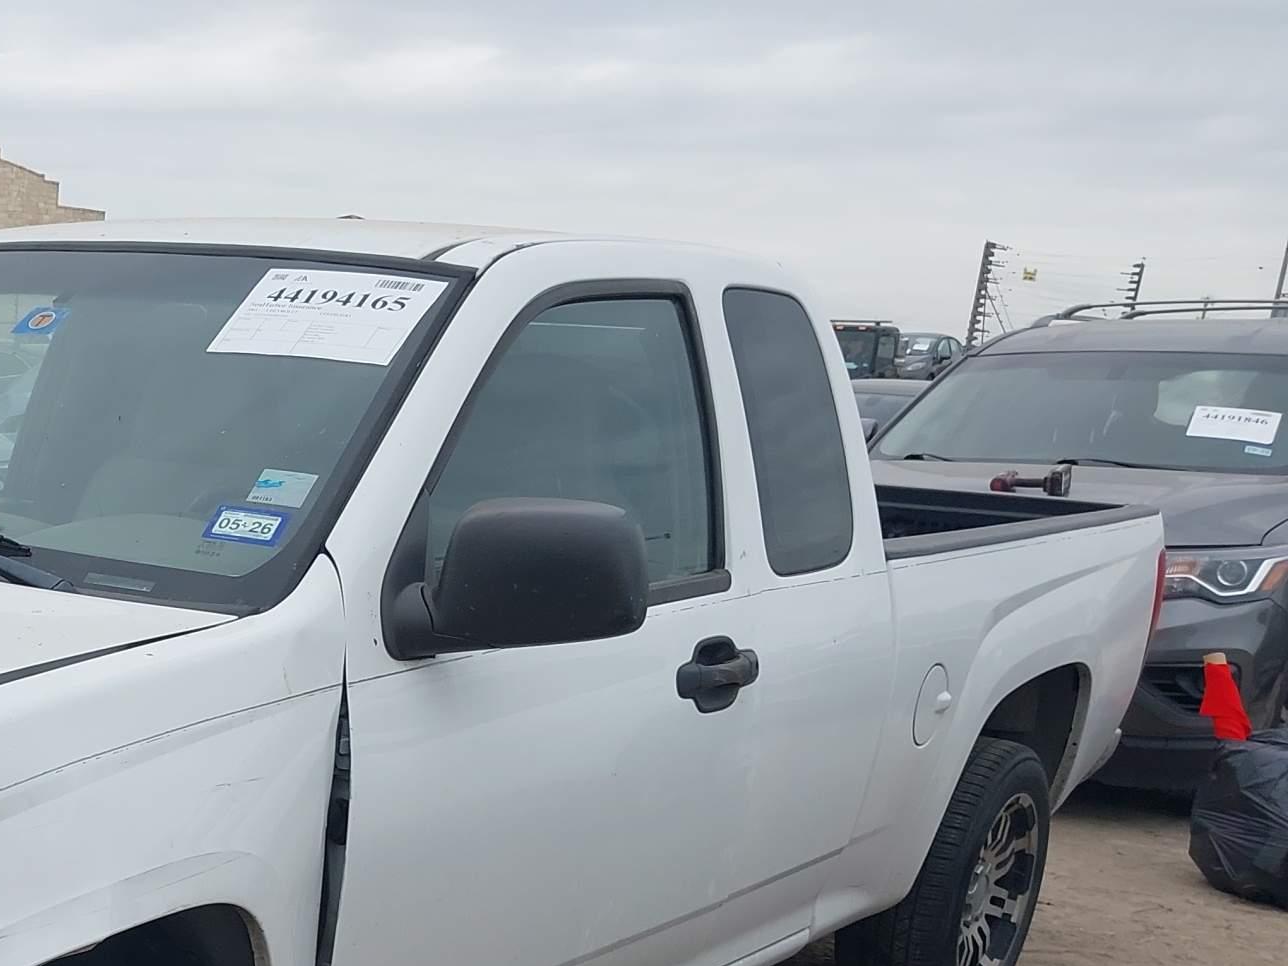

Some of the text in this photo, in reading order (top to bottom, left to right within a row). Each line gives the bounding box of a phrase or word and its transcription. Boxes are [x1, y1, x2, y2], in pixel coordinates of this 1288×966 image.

[266, 287, 411, 312] 44194165
[218, 517, 274, 535] 05 26
